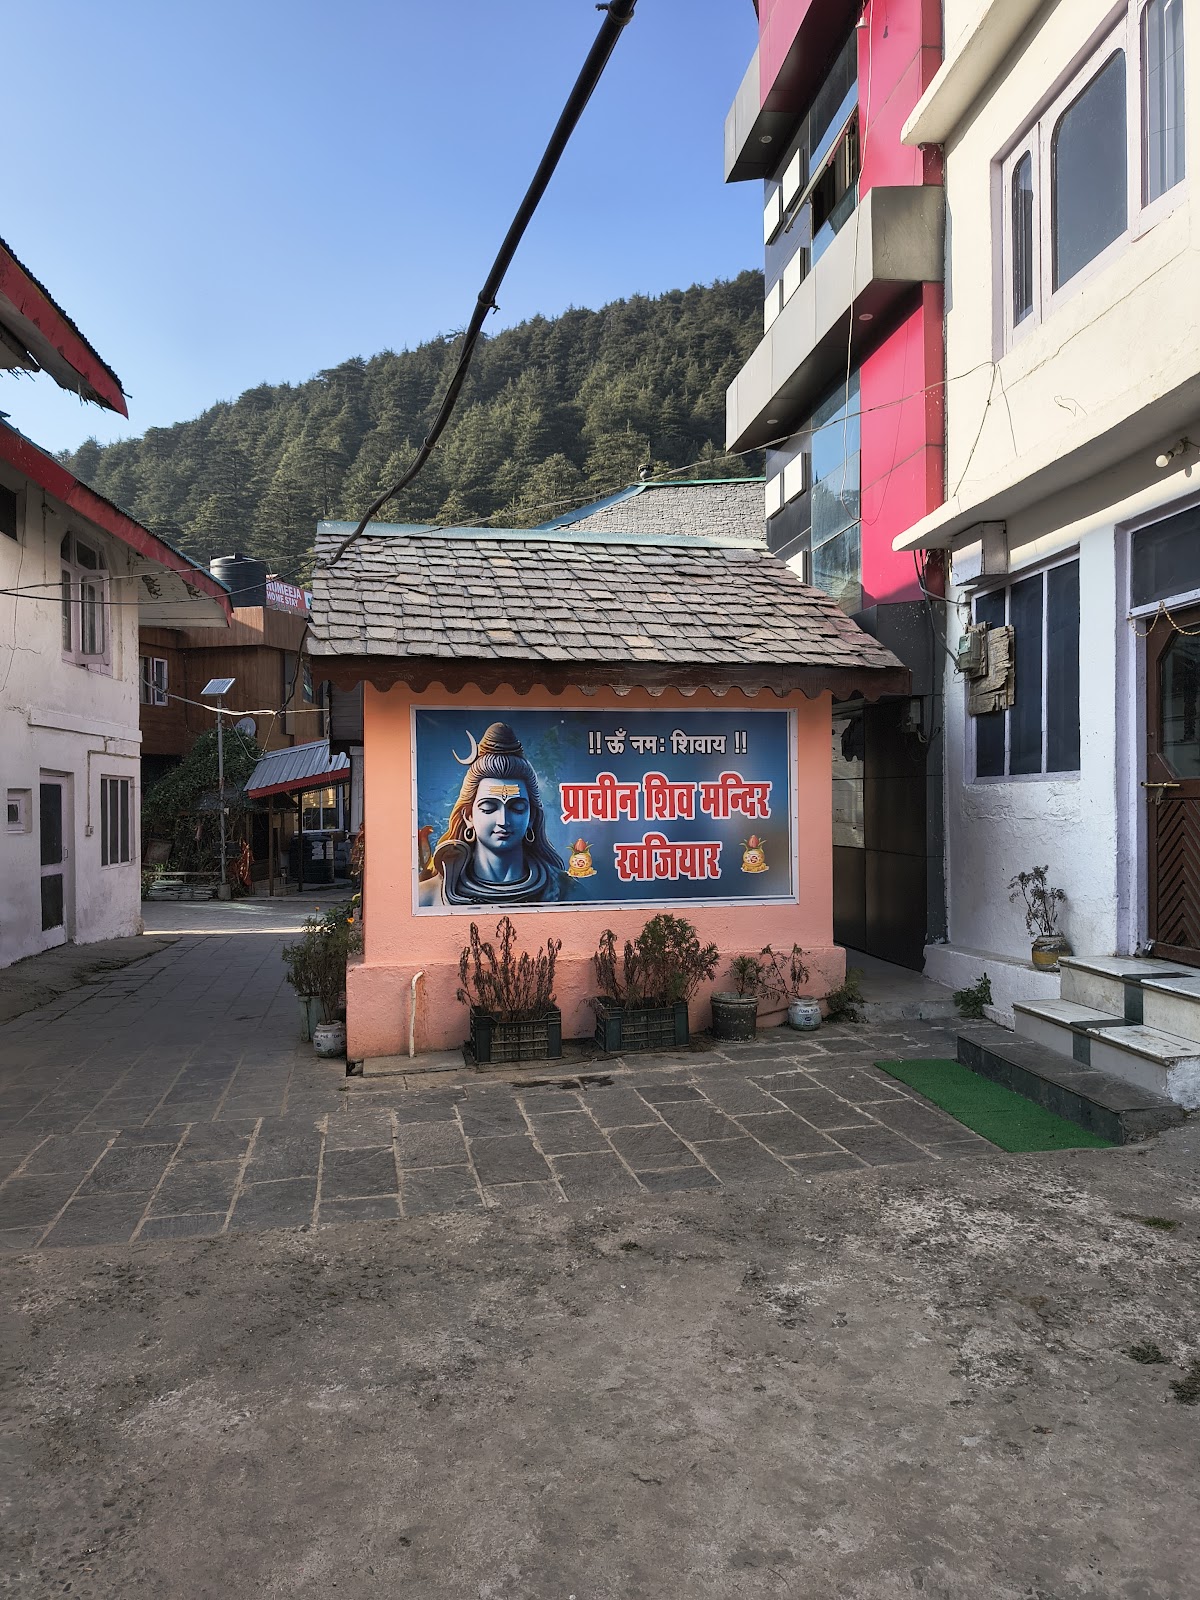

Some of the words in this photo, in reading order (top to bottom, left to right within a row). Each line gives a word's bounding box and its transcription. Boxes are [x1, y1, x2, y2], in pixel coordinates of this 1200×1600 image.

[266, 590, 285, 604] HOME
[285, 596, 299, 608] STAY
[670, 728, 727, 754] शिवाय
[559, 771, 641, 824] प्राचीन
[642, 770, 698, 820] शिव
[698, 770, 773, 820] मन्दिर
[613, 831, 723, 882] खजियार
